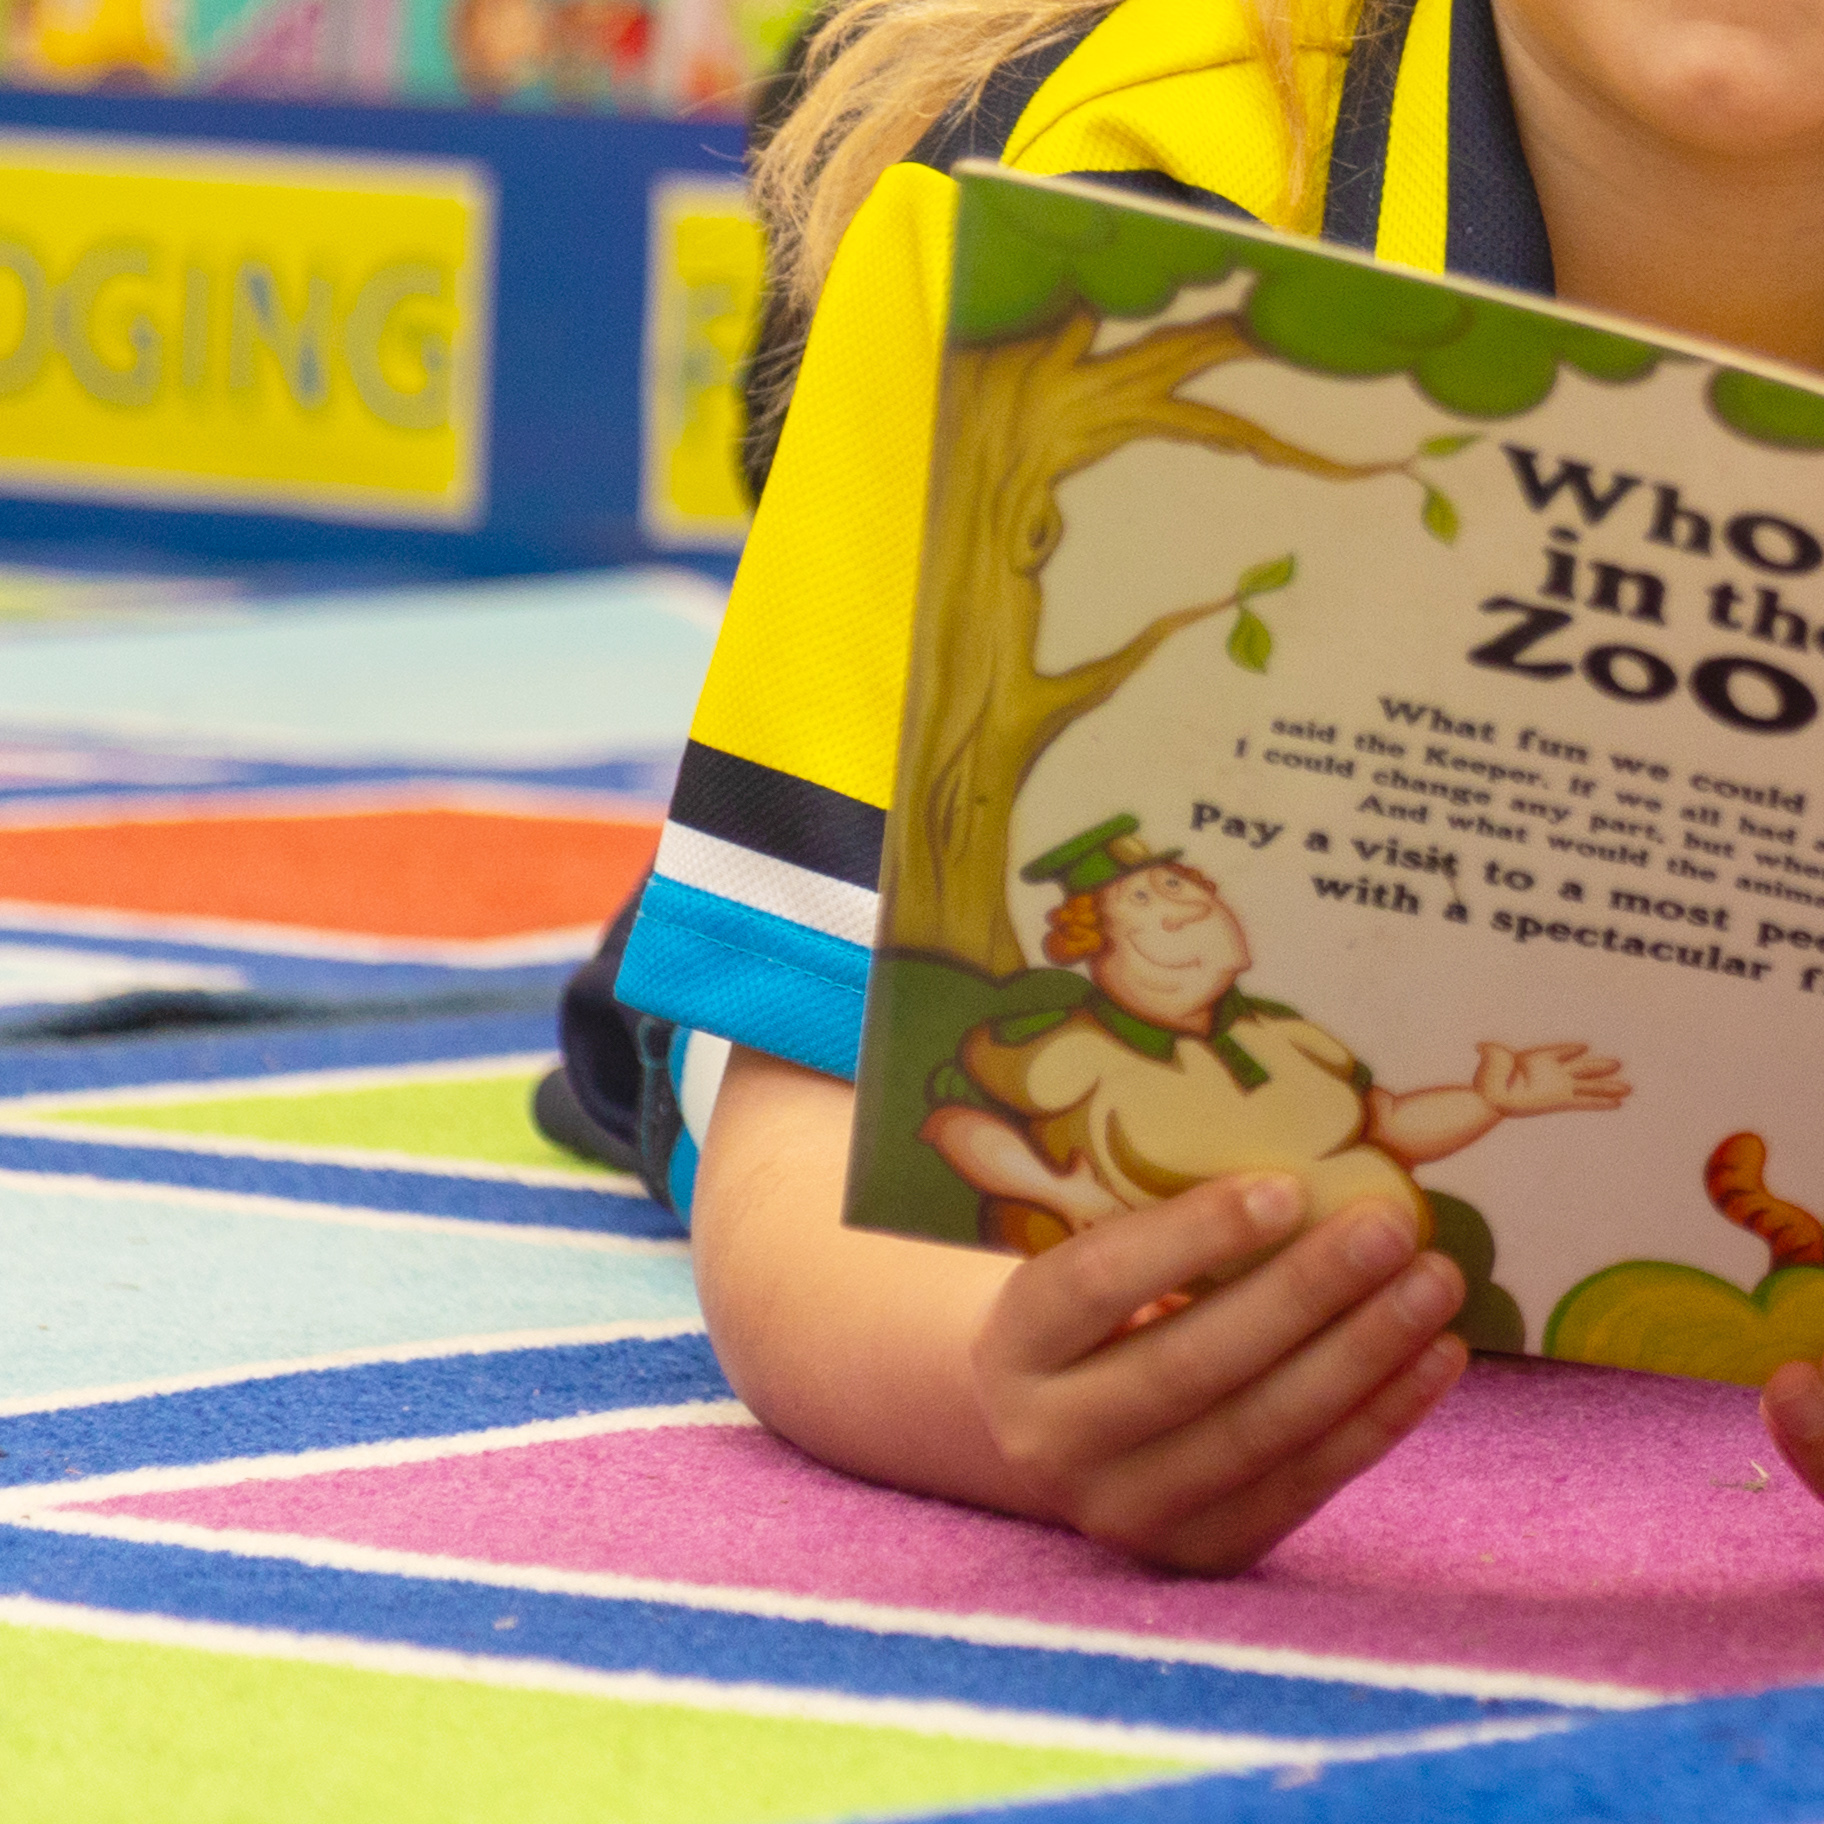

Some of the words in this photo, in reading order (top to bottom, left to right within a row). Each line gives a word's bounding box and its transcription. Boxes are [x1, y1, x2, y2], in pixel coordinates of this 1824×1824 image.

[1537, 525, 1668, 626] in
[1262, 746, 1356, 780] could
[1371, 767, 1493, 807] change
[1508, 794, 1572, 825] any
[1682, 830, 1736, 859] but
[1270, 717, 1337, 746] said
[1353, 731, 1407, 759] the
[1614, 789, 1664, 813] we
[1680, 804, 1722, 828] all
[1738, 815, 1798, 846] had
[1378, 694, 1497, 745] What
[1516, 726, 1590, 765] fun
[1609, 752, 1672, 784] we
[1689, 773, 1806, 816] could
[1189, 800, 1287, 851] Pay
[1304, 827, 1332, 854] a
[1352, 837, 1461, 879] visit
[1483, 860, 1536, 893] to
[1557, 879, 1585, 903] a
[1609, 886, 1731, 933] most
[1356, 794, 1430, 826] And
[1446, 810, 1529, 845] what
[1546, 832, 1650, 869] would
[1665, 855, 1719, 884] the
[1311, 874, 1421, 917] with
[1443, 899, 1471, 925] a
[1490, 908, 1774, 983] spectacular
